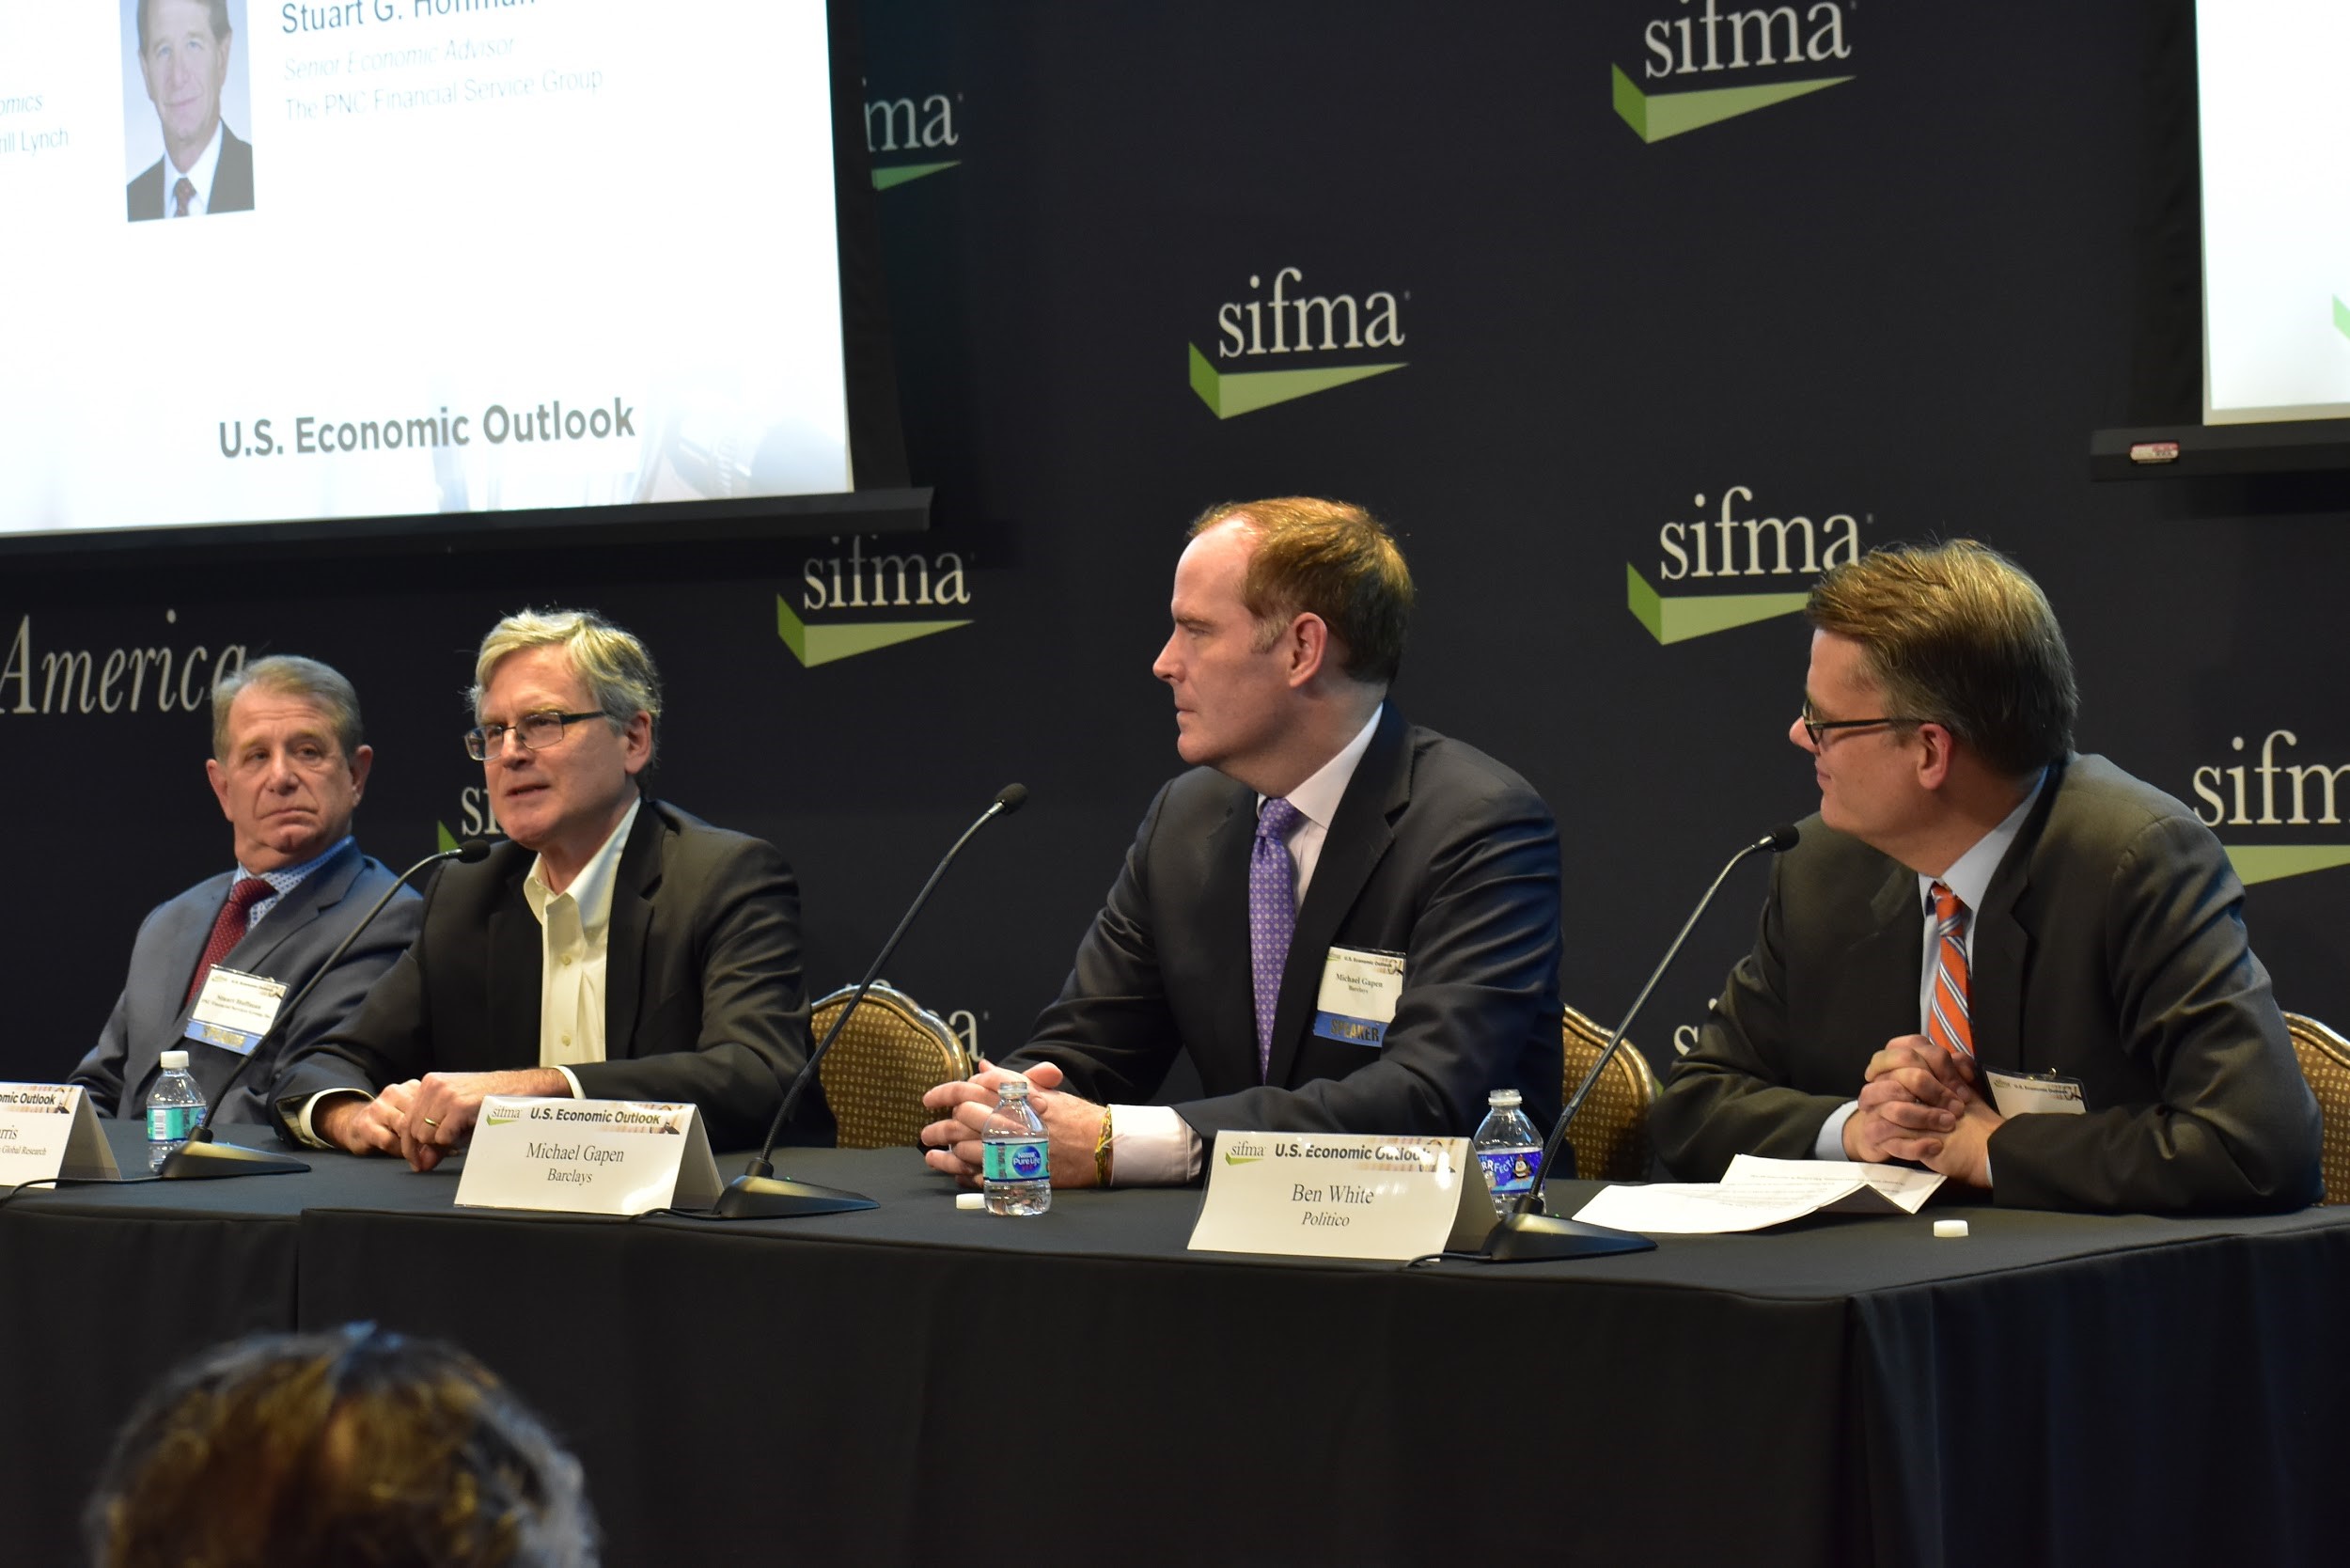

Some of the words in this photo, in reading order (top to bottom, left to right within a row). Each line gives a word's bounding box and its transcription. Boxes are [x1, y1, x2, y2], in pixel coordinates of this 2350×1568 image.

[282, 0, 364, 34] Stuart
[374, 0, 403, 22] G.
[1645, 0, 1852, 79] sifma
[284, 58, 339, 82] Senior
[347, 45, 438, 75] Economic
[444, 37, 516, 62] Advisor
[286, 99, 317, 120] The
[324, 90, 367, 116] PNC
[374, 81, 457, 113] Financial
[463, 76, 535, 102] Service
[542, 67, 604, 95] Group
[21, 126, 70, 157] Lynch
[1218, 266, 1406, 358] sifma
[219, 420, 284, 459] U.S.
[295, 405, 471, 454] Economic
[482, 397, 636, 445] Outlook
[1660, 485, 1859, 580] sifma
[804, 534, 971, 610] sifma
[20, 1092, 56, 1105] Outlook
[492, 1105, 520, 1120] sifma
[530, 1107, 553, 1121] U.S.
[556, 1108, 612, 1123] Economic
[615, 1111, 661, 1125] Outlook
[526, 1142, 580, 1162] Michael
[583, 1145, 624, 1167] Gapen
[1231, 1141, 1264, 1157] sifma
[1275, 1143, 1302, 1158] U.S.
[1306, 1144, 1371, 1161] Economic
[547, 1168, 592, 1186] Barclays
[1292, 1184, 1323, 1203] Ben
[1328, 1184, 1374, 1204] White
[1301, 1211, 1351, 1228] Politico
